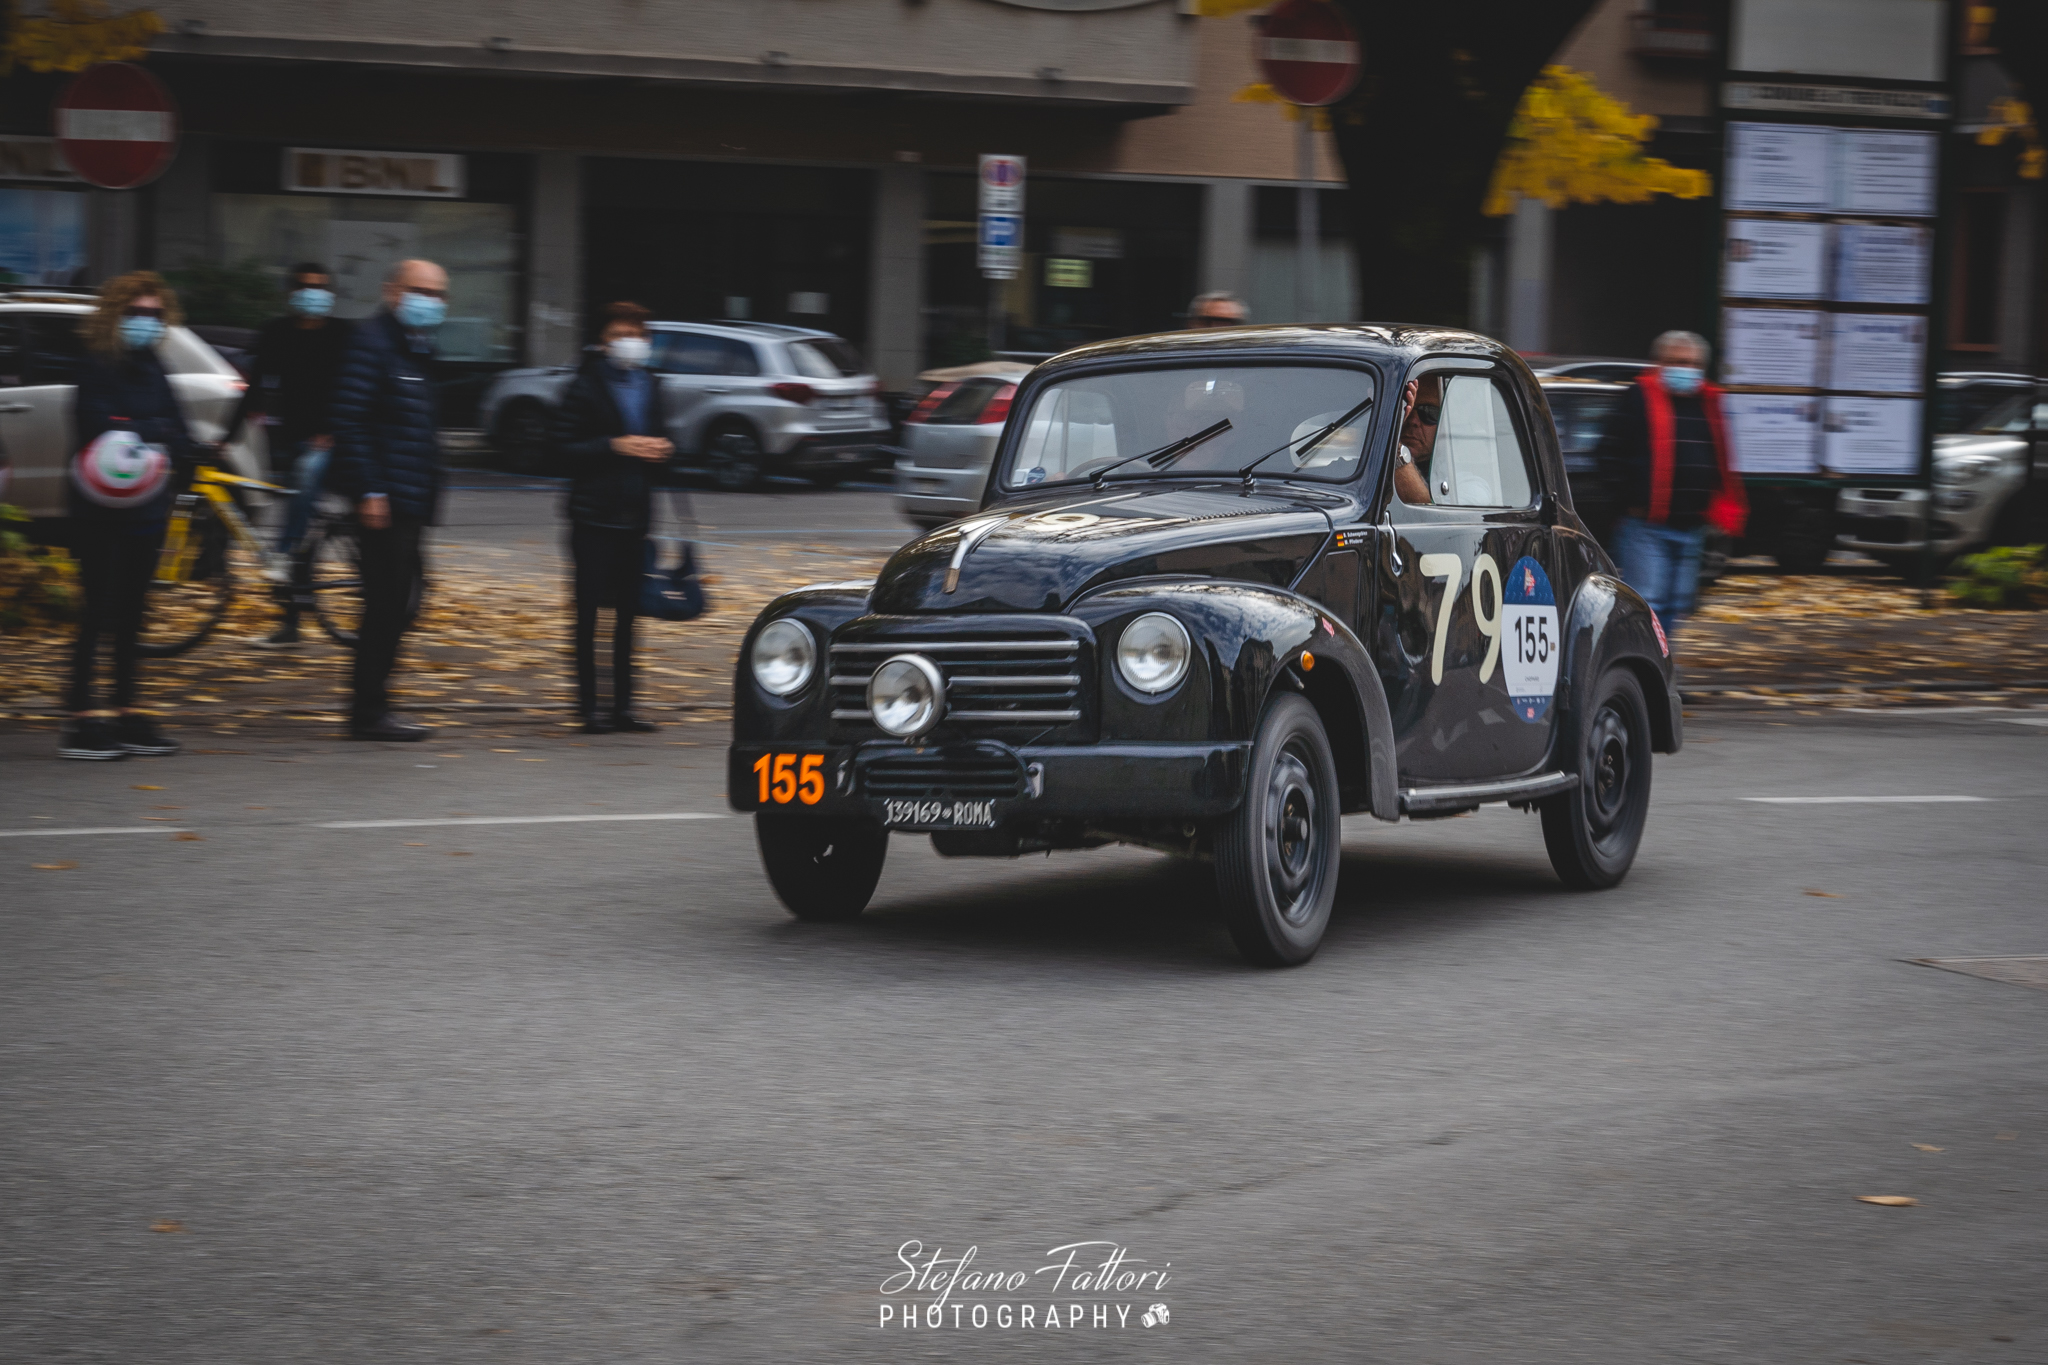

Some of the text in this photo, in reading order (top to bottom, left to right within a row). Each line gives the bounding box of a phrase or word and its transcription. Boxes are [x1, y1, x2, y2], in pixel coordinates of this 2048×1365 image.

[1419, 553, 1503, 686] 79
[1515, 616, 1549, 664] 155
[753, 753, 825, 805] 155
[953, 801, 992, 825] ROMA
